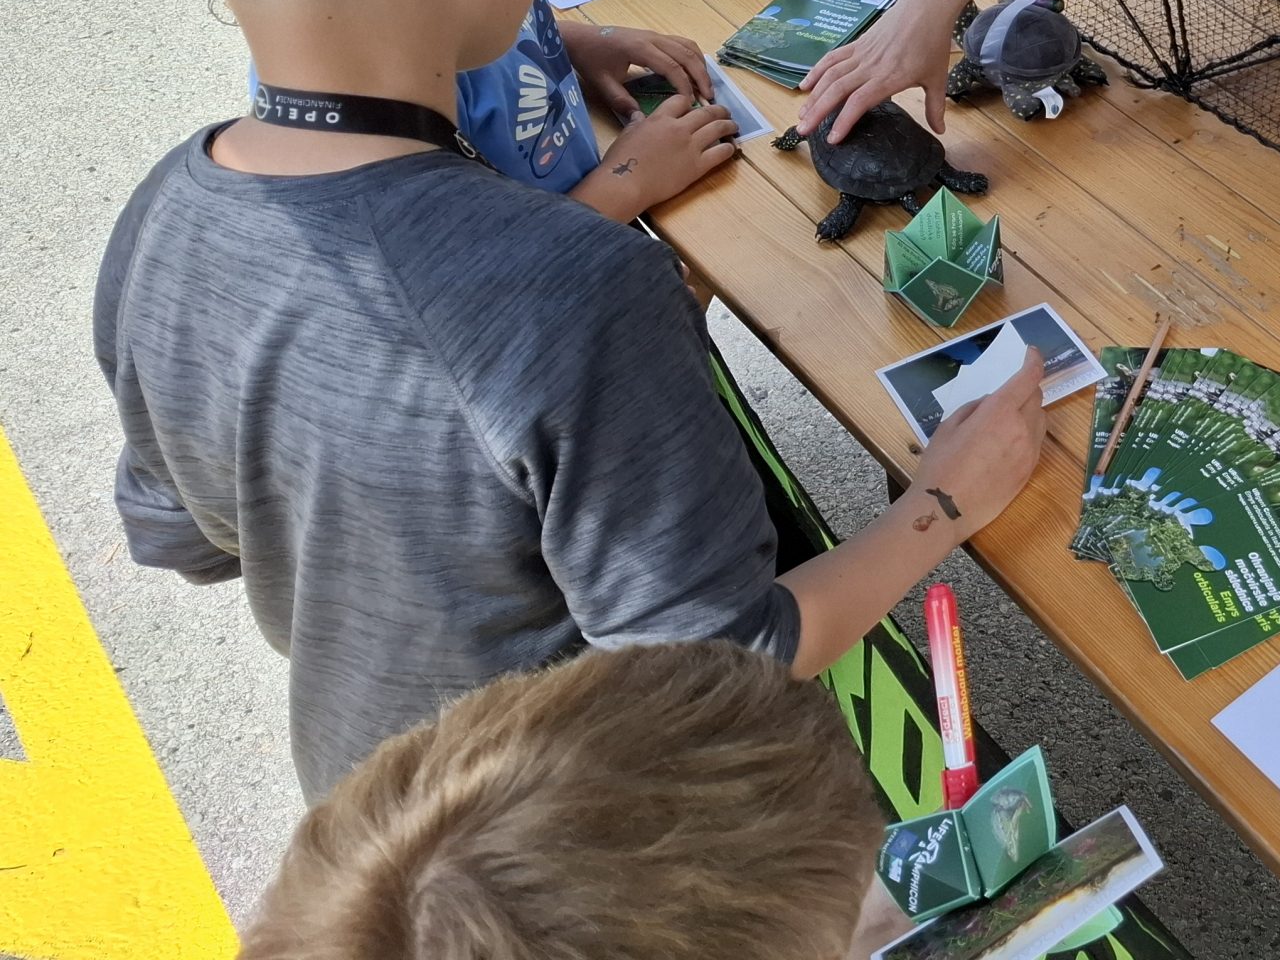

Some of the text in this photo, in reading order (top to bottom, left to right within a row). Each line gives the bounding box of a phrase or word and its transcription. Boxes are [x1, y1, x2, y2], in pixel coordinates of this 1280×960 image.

[276, 106, 339, 123] OPEL
[515, 63, 548, 143] FIND
[1271, 536, 1280, 548] Italy
[1194, 572, 1225, 622] orbicularis
[1225, 570, 1253, 611] sklednice
[1235, 559, 1267, 606] močvirske
[1249, 552, 1280, 600] Ohranjanje
[1220, 591, 1239, 617] Emys
[952, 626, 962, 666] marker
[956, 670, 971, 740] Whiteboard
